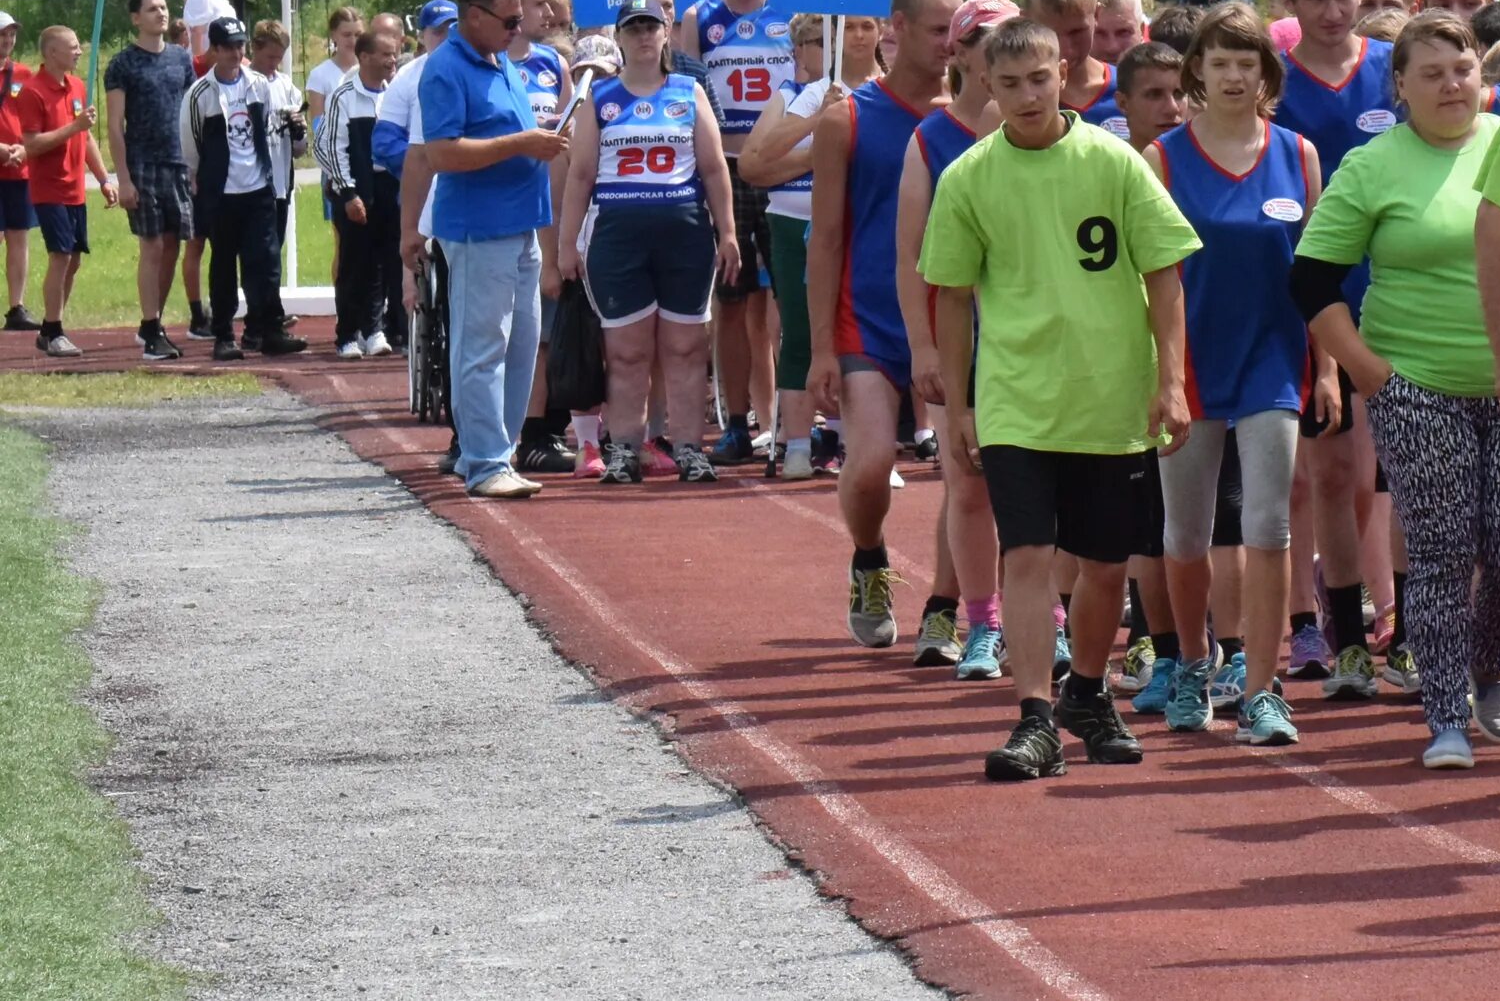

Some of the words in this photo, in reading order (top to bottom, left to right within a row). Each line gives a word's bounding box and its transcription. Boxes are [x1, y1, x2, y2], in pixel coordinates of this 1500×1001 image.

[726, 67, 773, 103] 13
[616, 145, 676, 178] 20
[1077, 215, 1118, 273] 9
